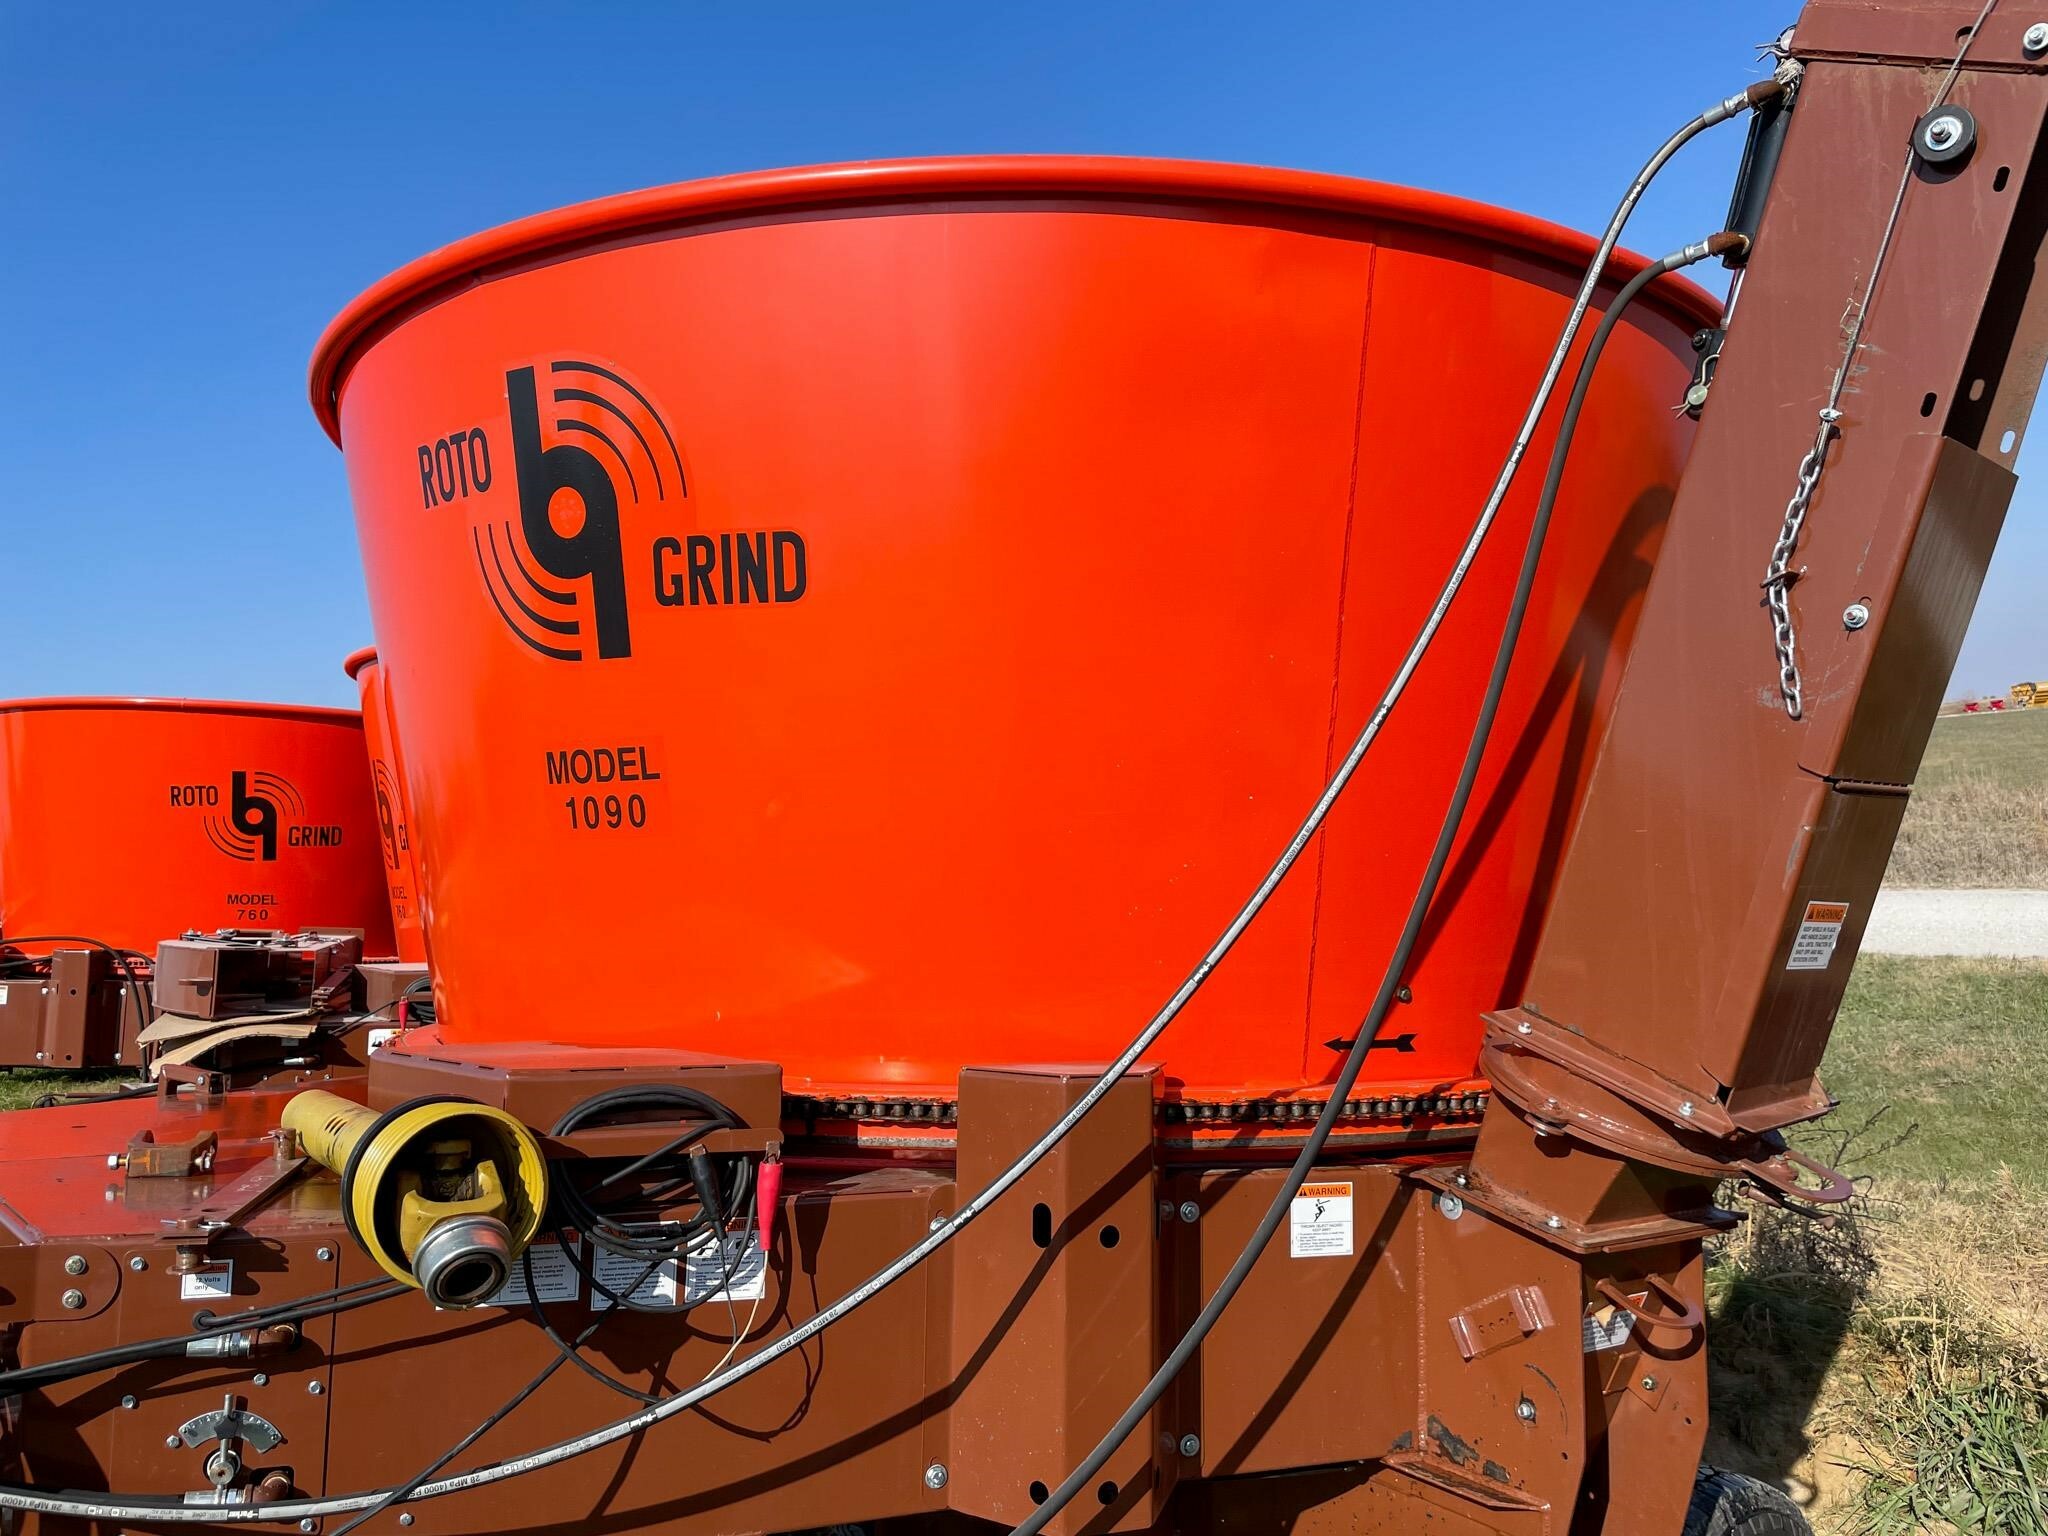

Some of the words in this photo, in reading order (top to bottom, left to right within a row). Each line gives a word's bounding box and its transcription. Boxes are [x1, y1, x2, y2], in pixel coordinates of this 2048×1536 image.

[418, 427, 492, 509] ROTO
[652, 530, 807, 607] GRIND
[546, 746, 661, 784] MODEL
[170, 785, 219, 807] ROTO
[565, 794, 647, 829] 1090
[288, 826, 342, 847] GRIND
[227, 894, 278, 905] MODEL
[237, 909, 268, 921] 760
[1308, 1186, 1347, 1196] WARNING
[828, 1309, 839, 1318] 28
[449, 1479, 468, 1488] MPa
[470, 1475, 480, 1484] 28
[424, 1482, 448, 1493] (4000
[1, 1496, 27, 1507] (4000
[29, 1500, 49, 1510] MPa
[51, 1503, 63, 1511] 28
